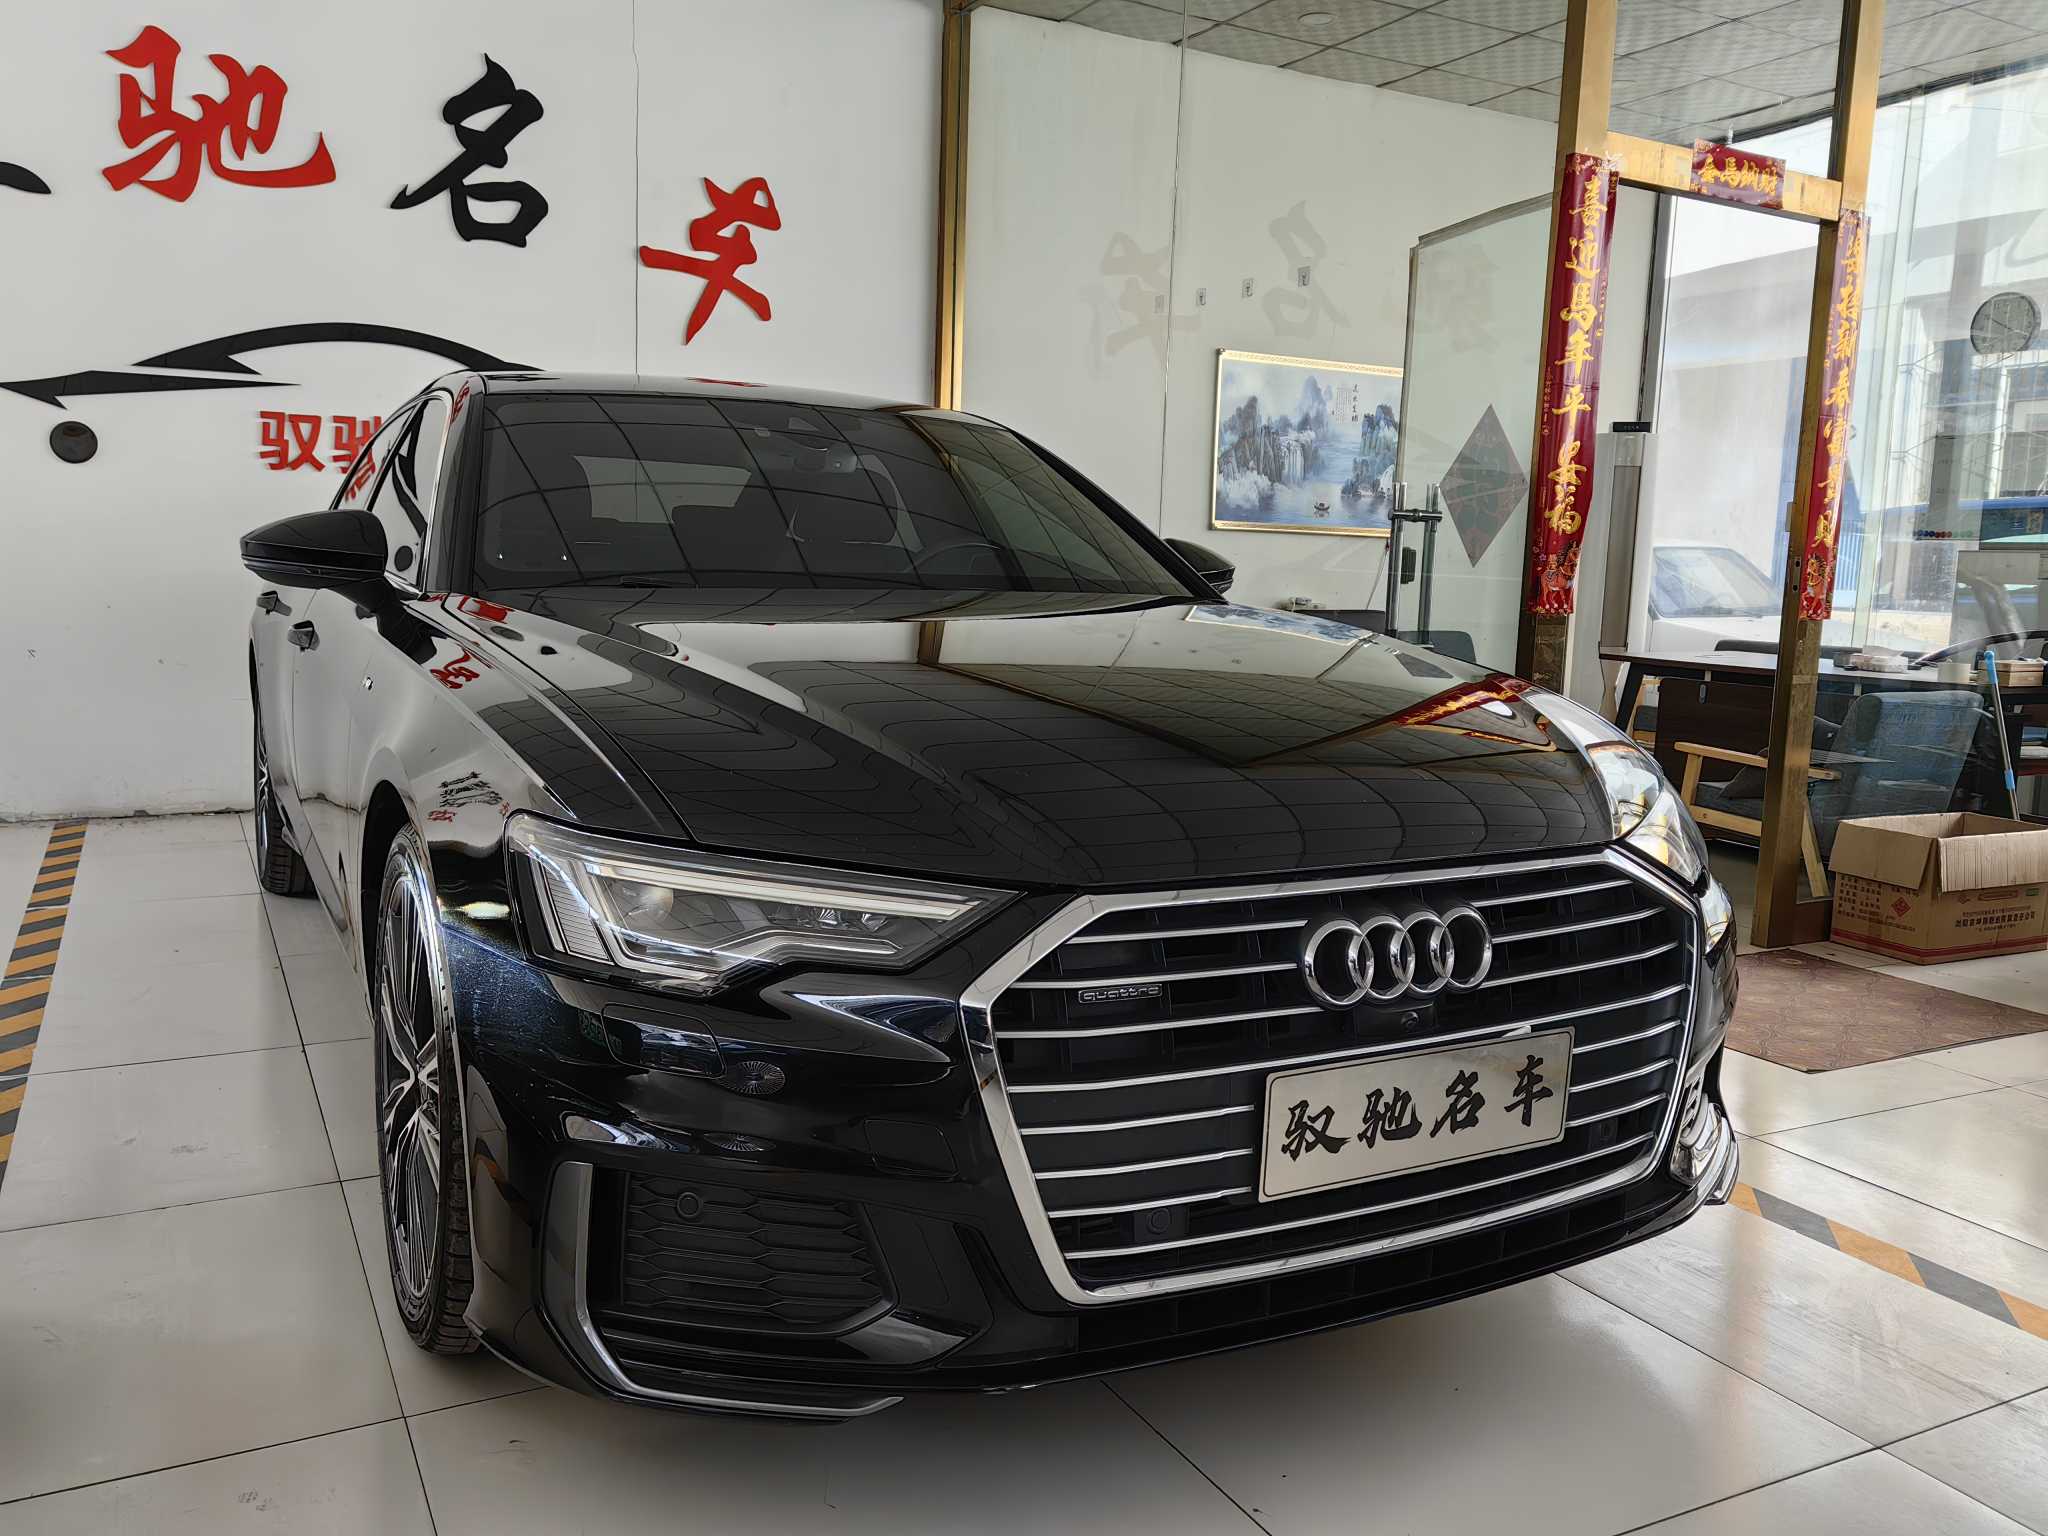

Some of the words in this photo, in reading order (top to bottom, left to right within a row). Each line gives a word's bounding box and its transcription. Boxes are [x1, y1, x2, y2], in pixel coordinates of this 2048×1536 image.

[0, 25, 782, 345] 驰名车
[1083, 986, 1160, 1001] quattro
[1279, 1053, 1555, 1161] 驭驰名车
